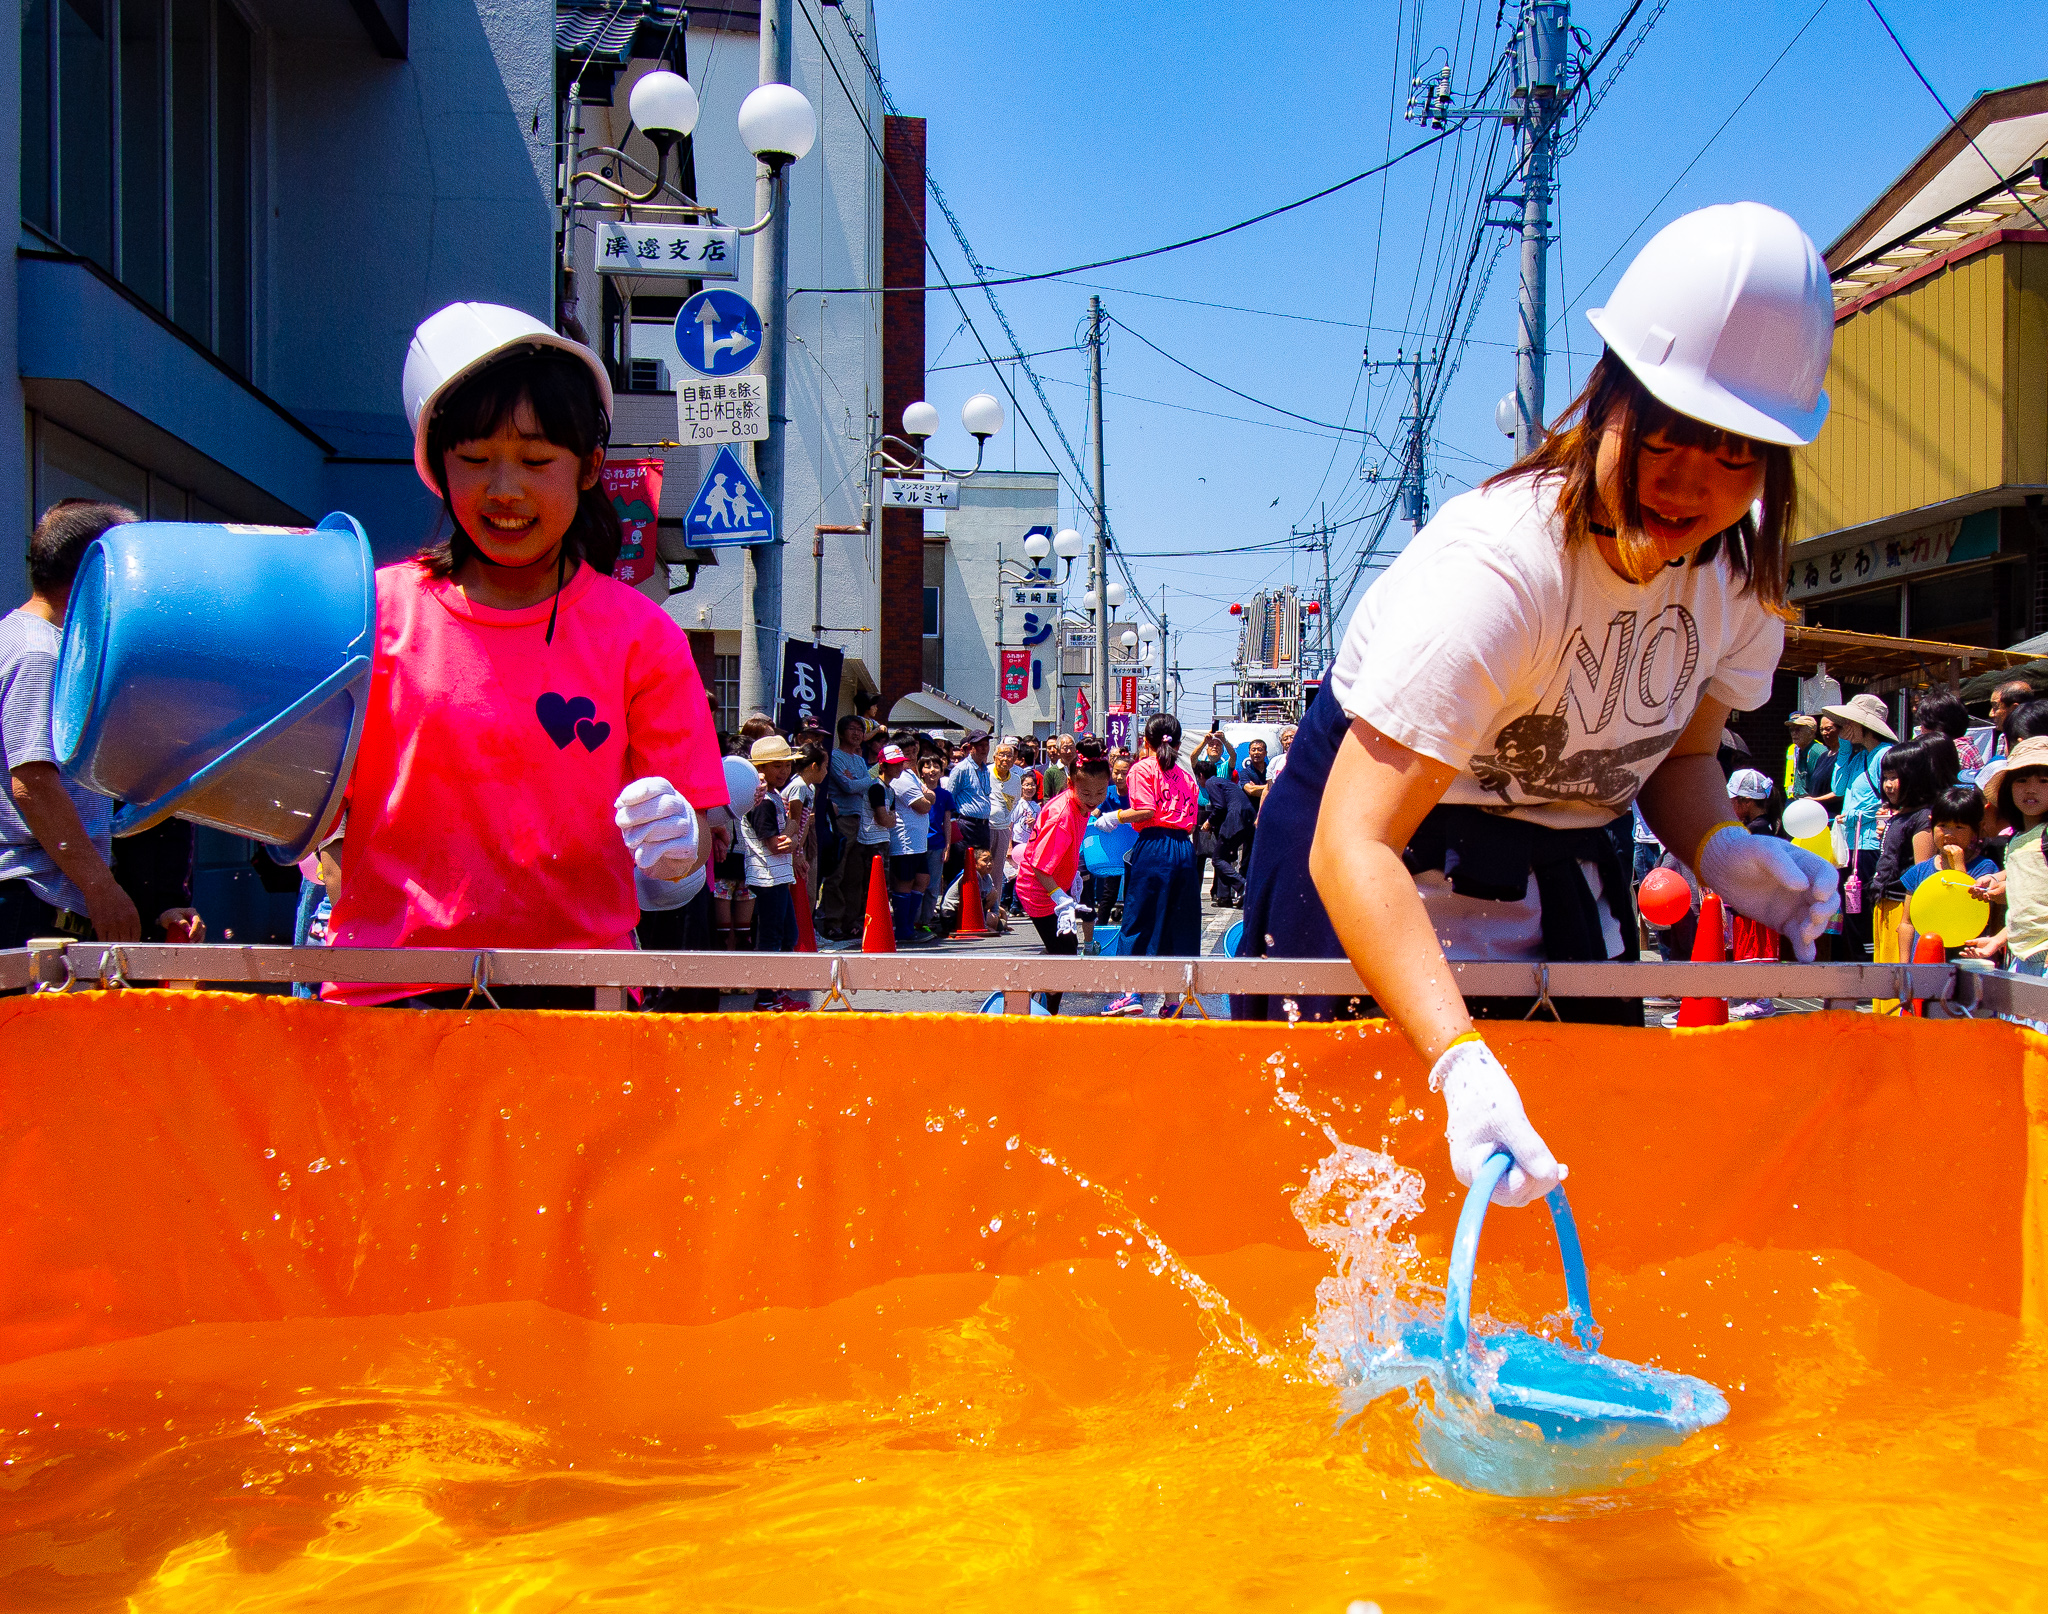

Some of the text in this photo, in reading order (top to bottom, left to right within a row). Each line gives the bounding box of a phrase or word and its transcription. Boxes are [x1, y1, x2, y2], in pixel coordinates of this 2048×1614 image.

[605, 236, 727, 261] 澤邊支店
[683, 382, 761, 402] 自転車を除く
[603, 467, 647, 480] ふれあい
[609, 480, 639, 491] ロード
[900, 483, 942, 491] メンズショップ
[892, 491, 949, 504] マルミヤ
[1015, 592, 1058, 604] 岩崎屋
[1533, 603, 1700, 734] NO
